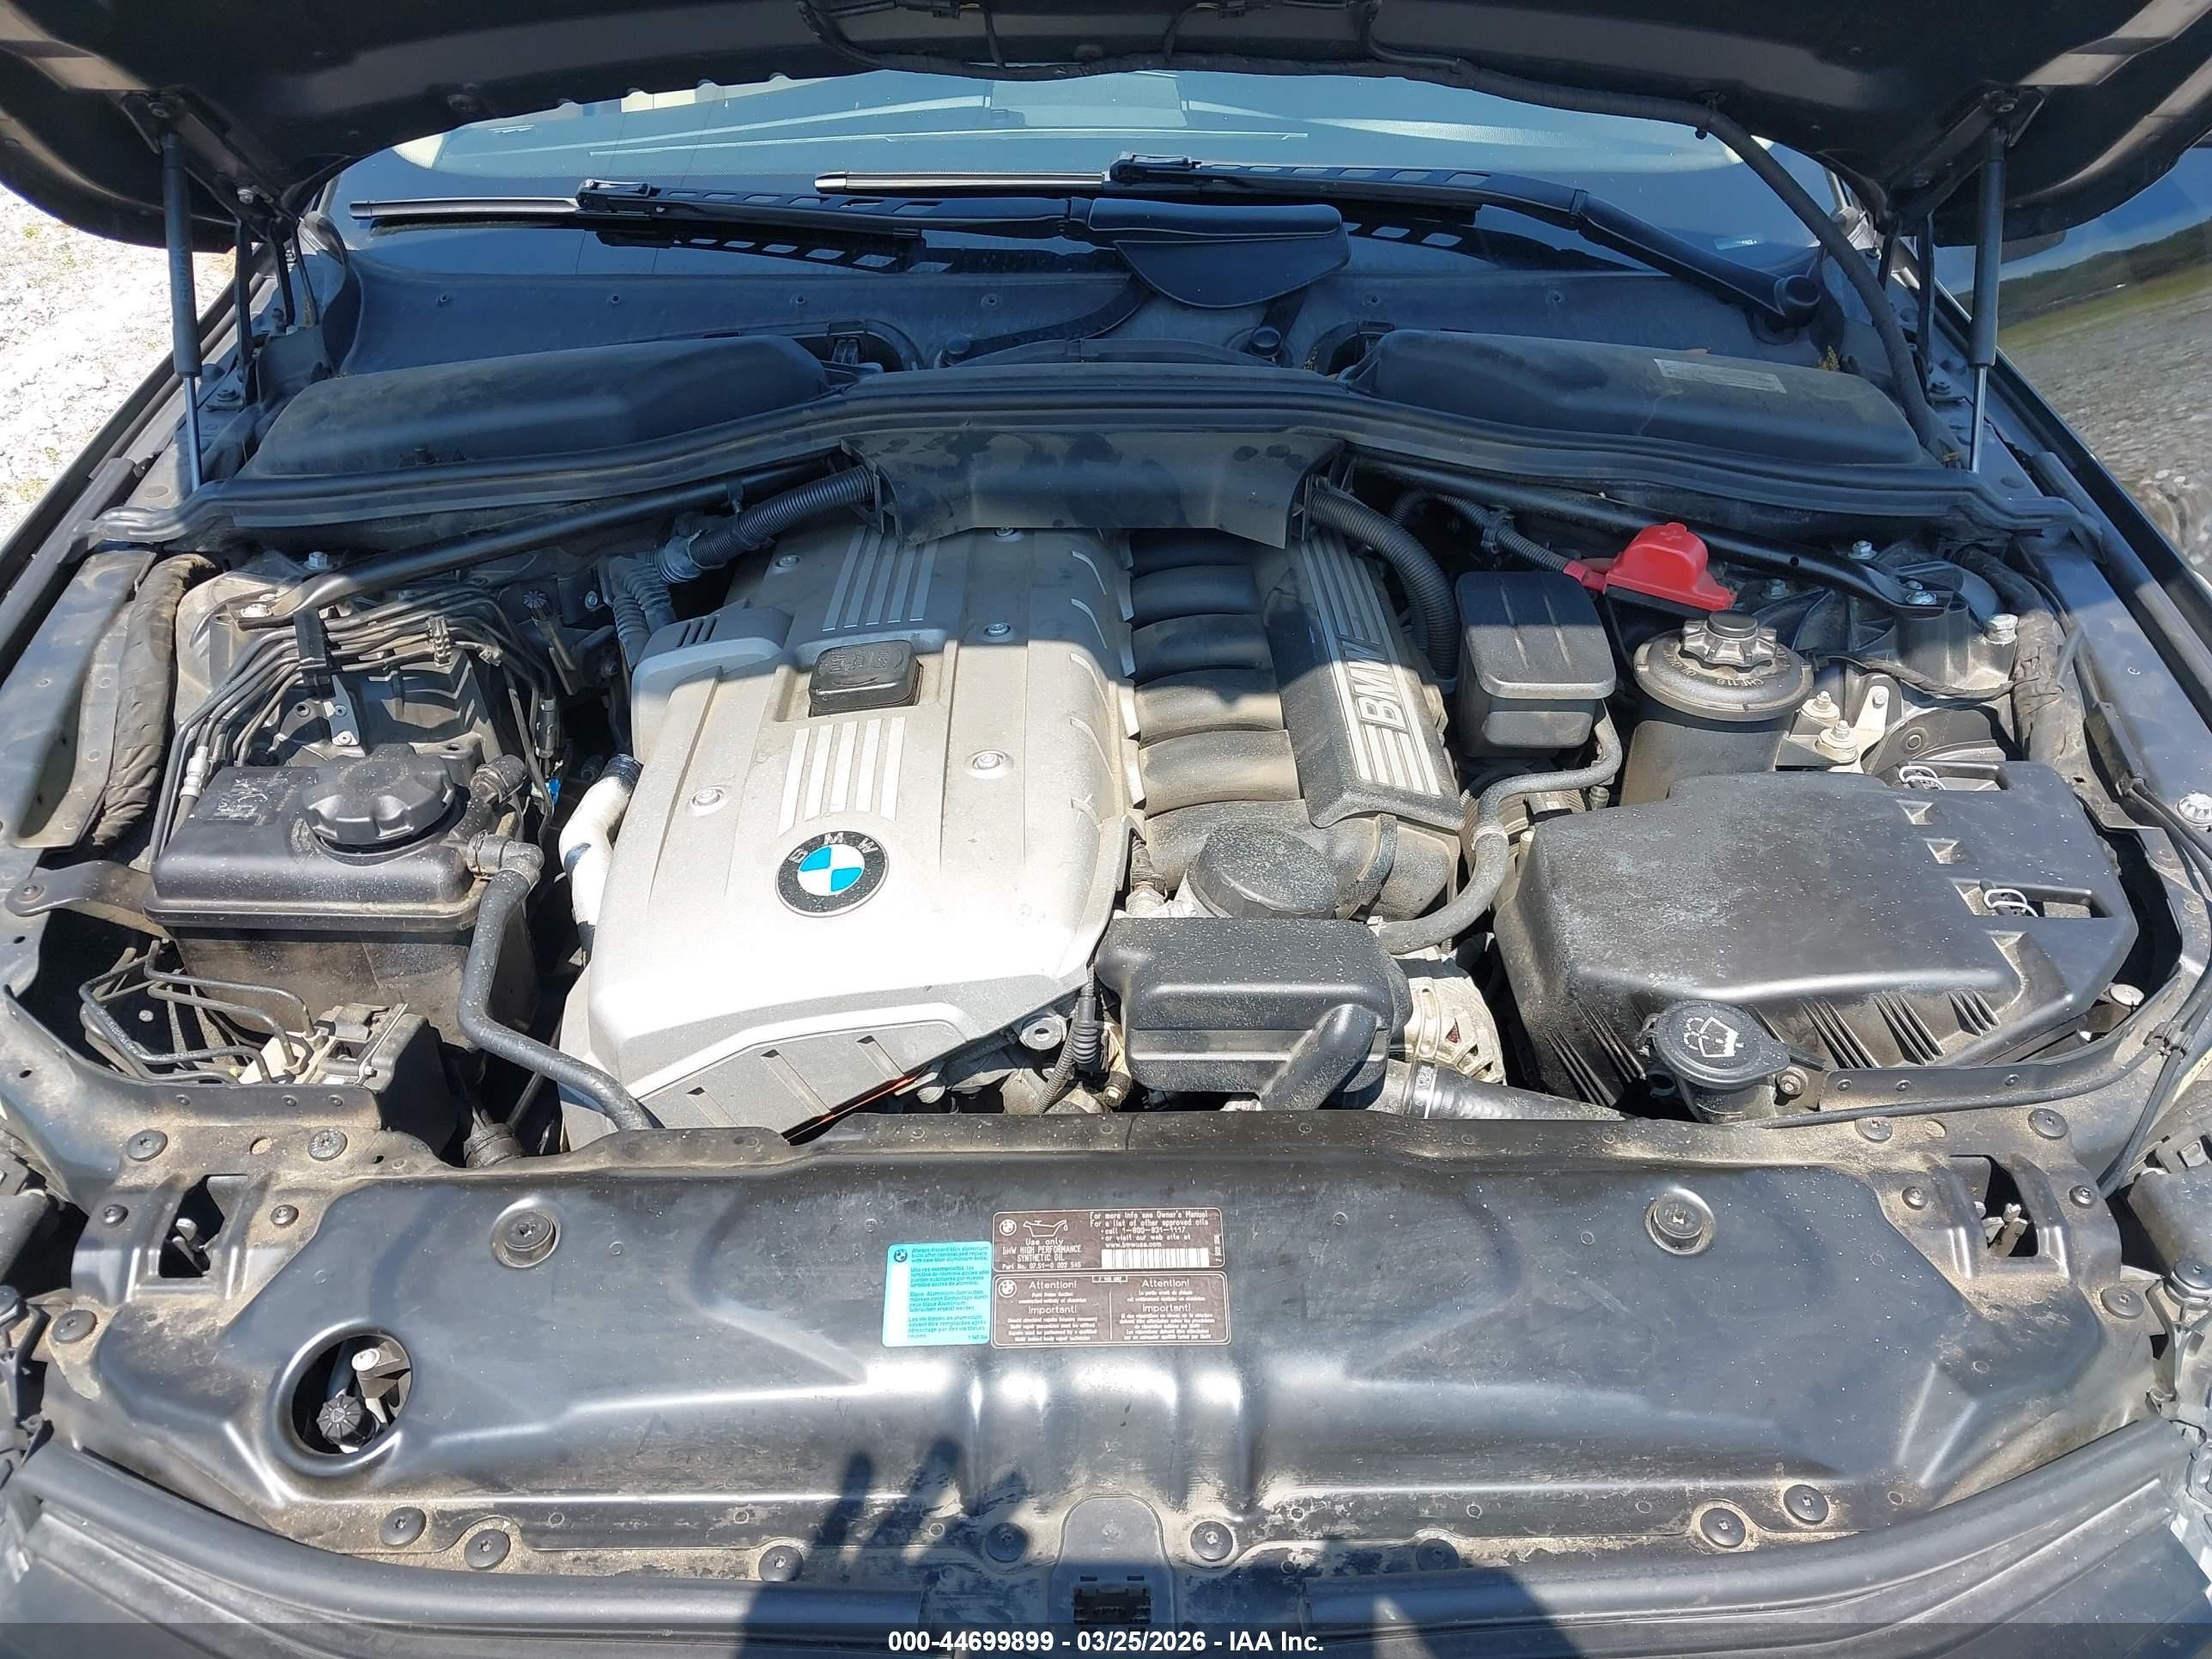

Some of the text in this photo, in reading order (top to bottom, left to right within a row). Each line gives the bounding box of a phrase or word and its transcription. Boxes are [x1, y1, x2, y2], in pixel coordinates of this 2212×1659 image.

[1341, 641, 1409, 732] BMW
[787, 832, 878, 863] BMW
[1185, 1210, 1208, 1218] Manual
[1128, 1218, 1137, 1227] of
[1162, 1218, 1192, 1227] approved
[1194, 1218, 1209, 1226] oils
[1045, 1237, 1064, 1247] only
[1002, 1246, 1017, 1255] BMW
[1037, 1244, 1082, 1254] PERFORMANCE
[1017, 1254, 1051, 1262] SYNTHETIC
[1029, 1280, 1077, 1289] Attention!
[1141, 1279, 1190, 1287] Attention!
[1029, 1304, 1077, 1315] Important!
[1142, 1304, 1191, 1313] Important!
